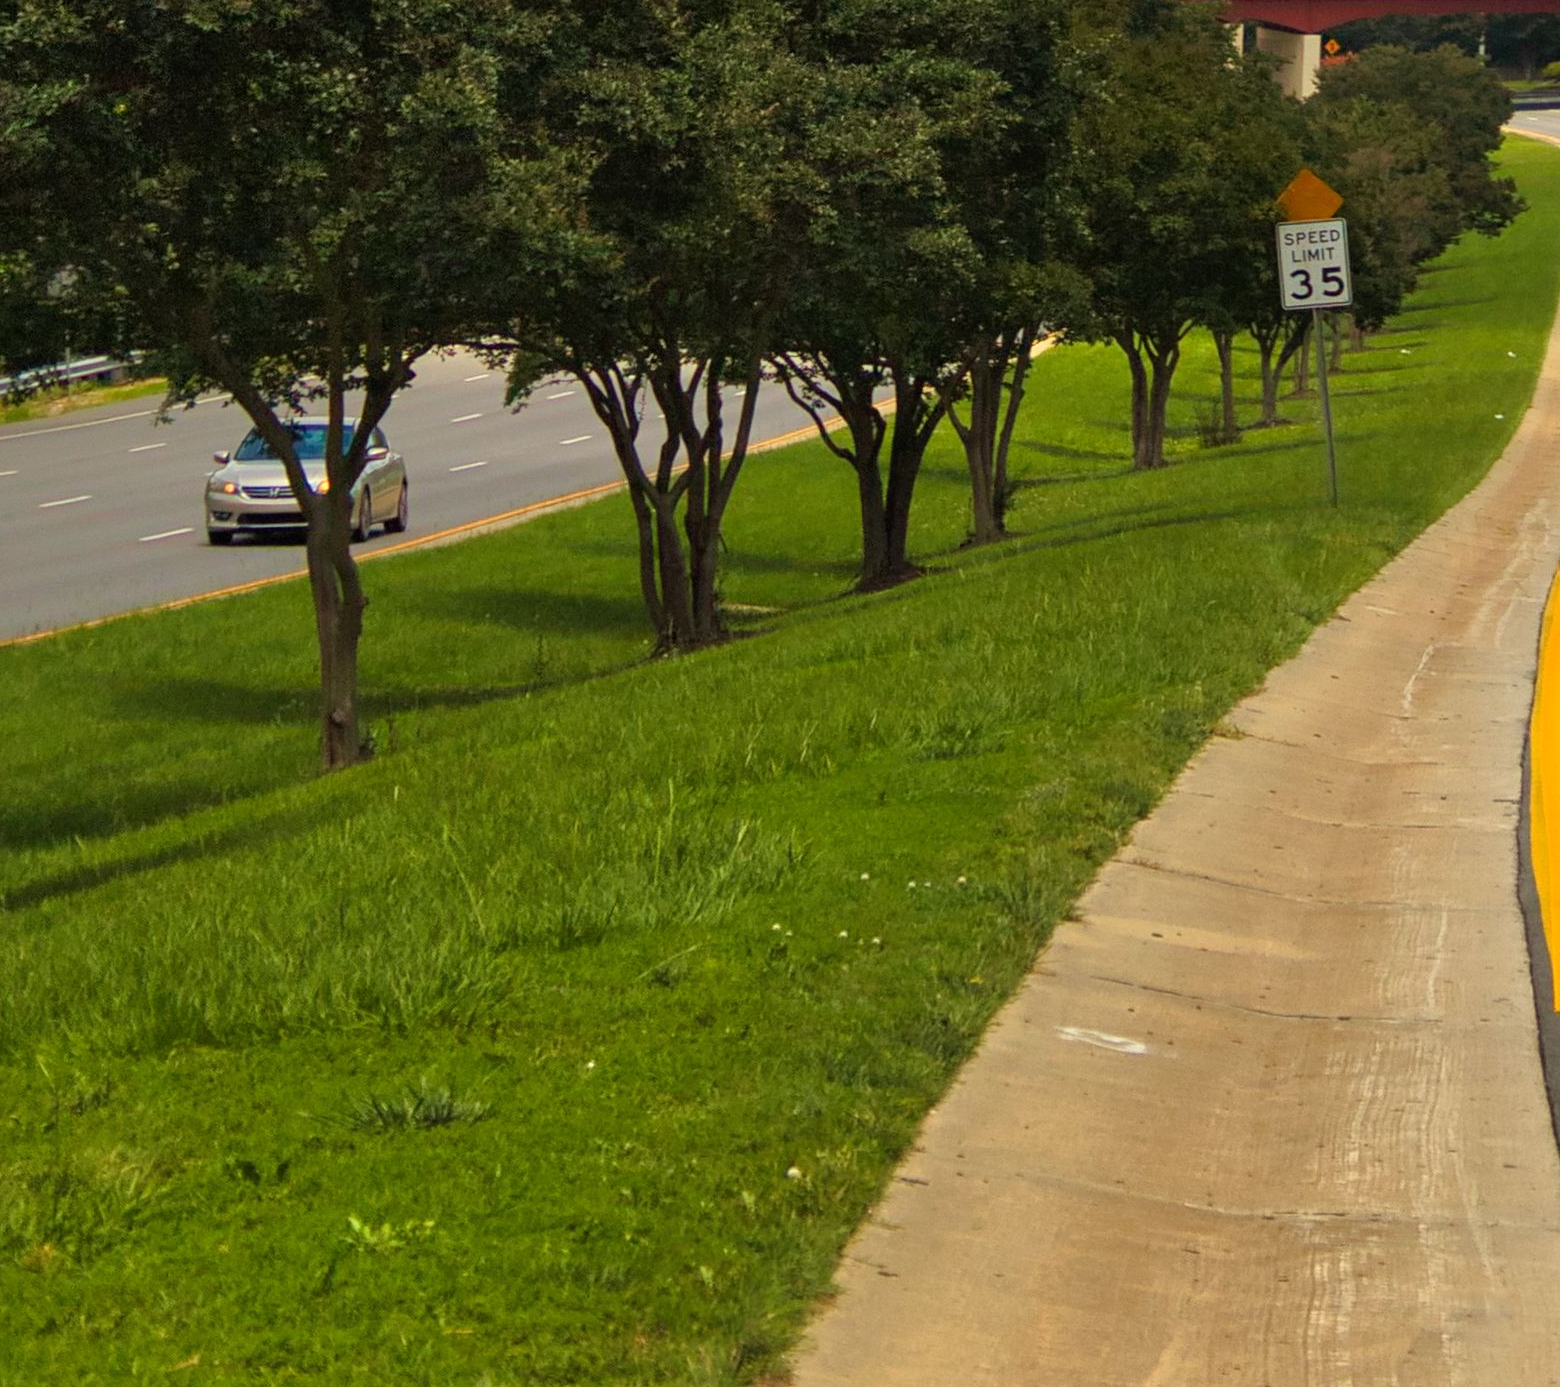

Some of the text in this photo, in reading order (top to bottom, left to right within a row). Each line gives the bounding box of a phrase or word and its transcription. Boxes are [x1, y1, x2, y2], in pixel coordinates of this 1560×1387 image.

[1283, 229, 1341, 246] SPEED
[1291, 246, 1334, 263] LIMIT
[1289, 266, 1345, 300] 35
